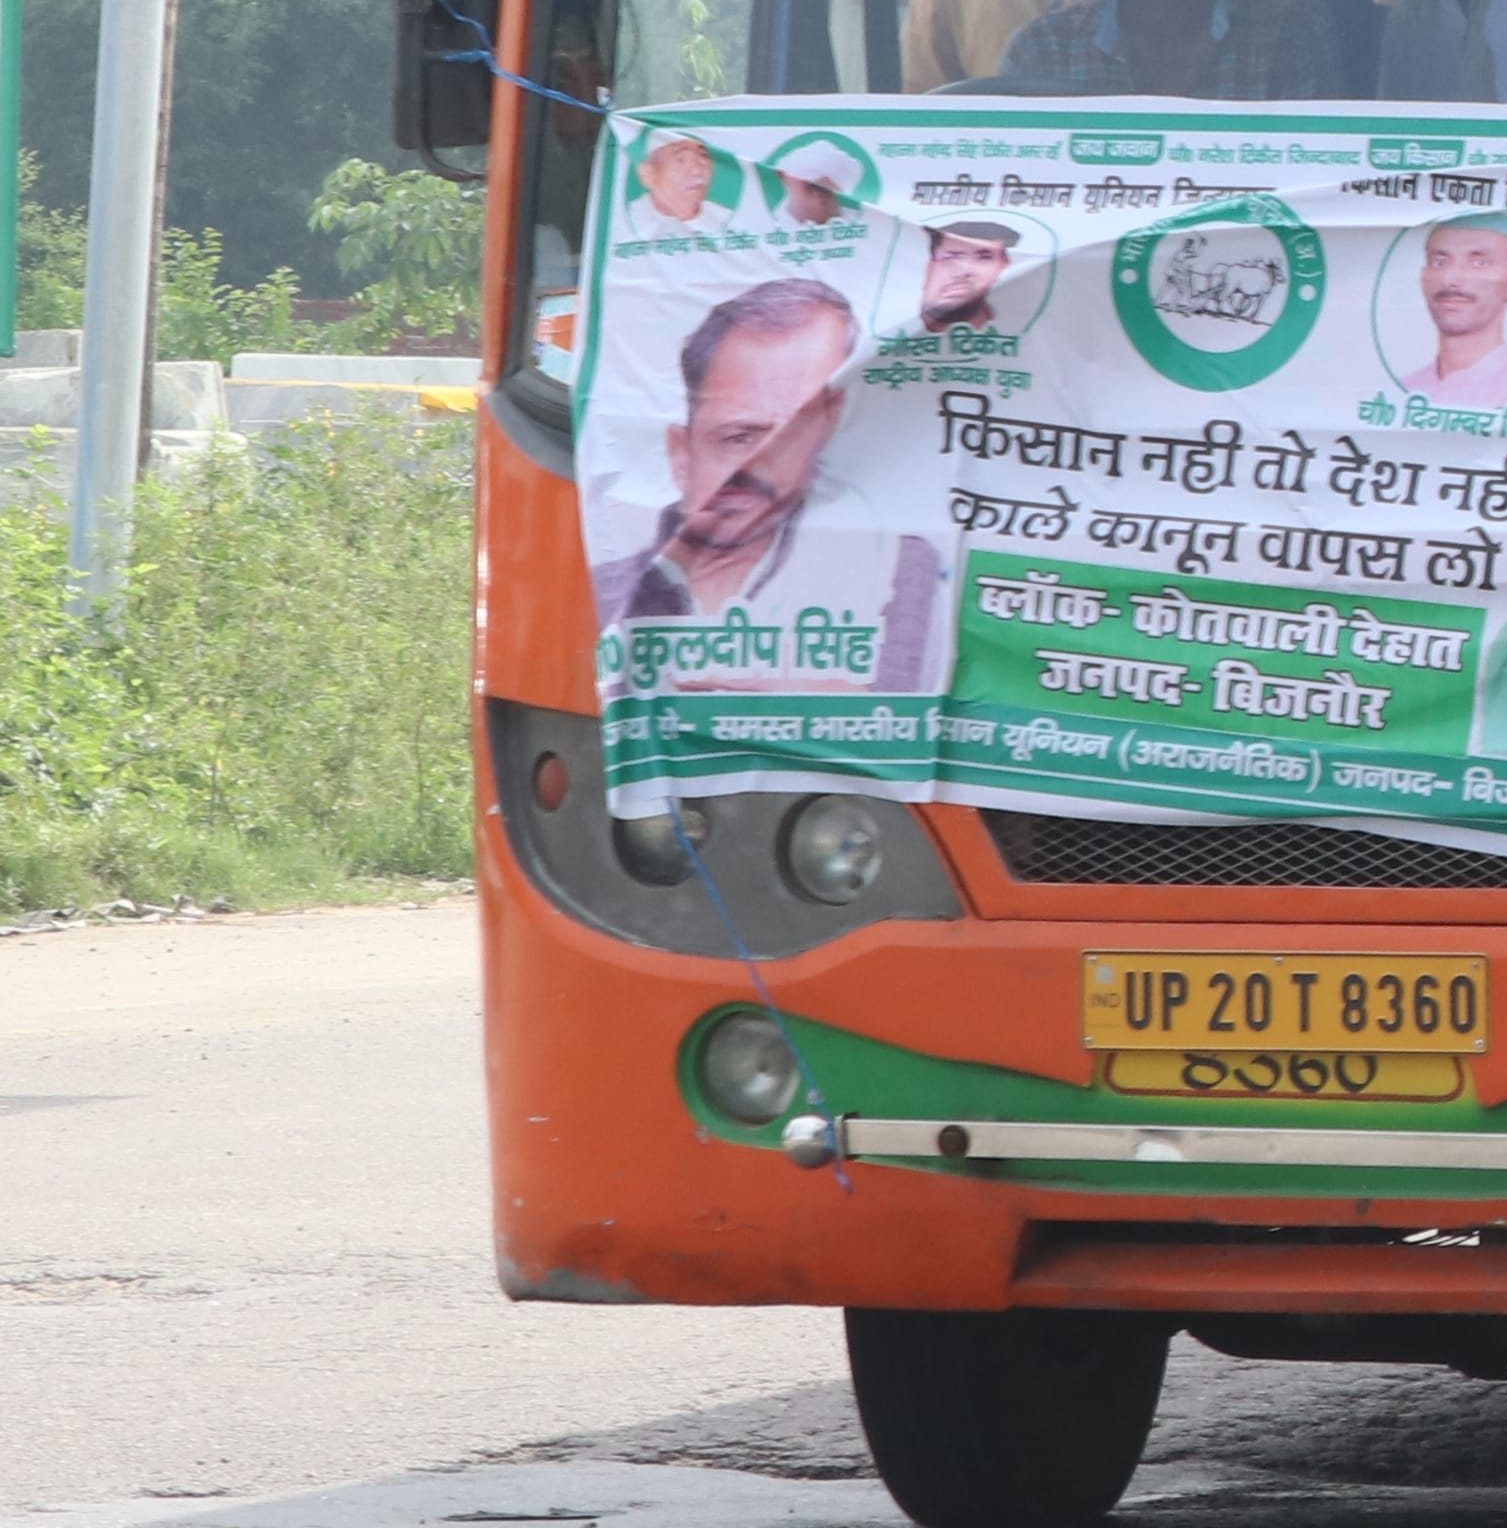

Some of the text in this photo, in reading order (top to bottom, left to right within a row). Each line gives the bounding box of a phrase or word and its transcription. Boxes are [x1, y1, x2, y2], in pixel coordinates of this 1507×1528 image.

[1000, 174, 1076, 207] किसान
[938, 390, 1127, 479] किसान
[1140, 419, 1243, 495] नही
[1252, 430, 1314, 494] तो
[1328, 435, 1427, 508] देश
[947, 485, 1504, 591] काले कानून वापस लो
[630, 605, 783, 690] कुलदीप
[794, 606, 879, 674] सिंह
[1129, 587, 1349, 658] कोतवाली
[1348, 608, 1470, 671] देहात
[1034, 648, 1392, 731] जनपद- बिजनौर
[710, 715, 805, 742] समस्त
[808, 705, 919, 742] भारतीय
[1000, 717, 1114, 762] यूनियन
[1118, 728, 1322, 793] (अराजनैतिक)
[1125, 970, 1477, 1034] UP 20 T 8360
